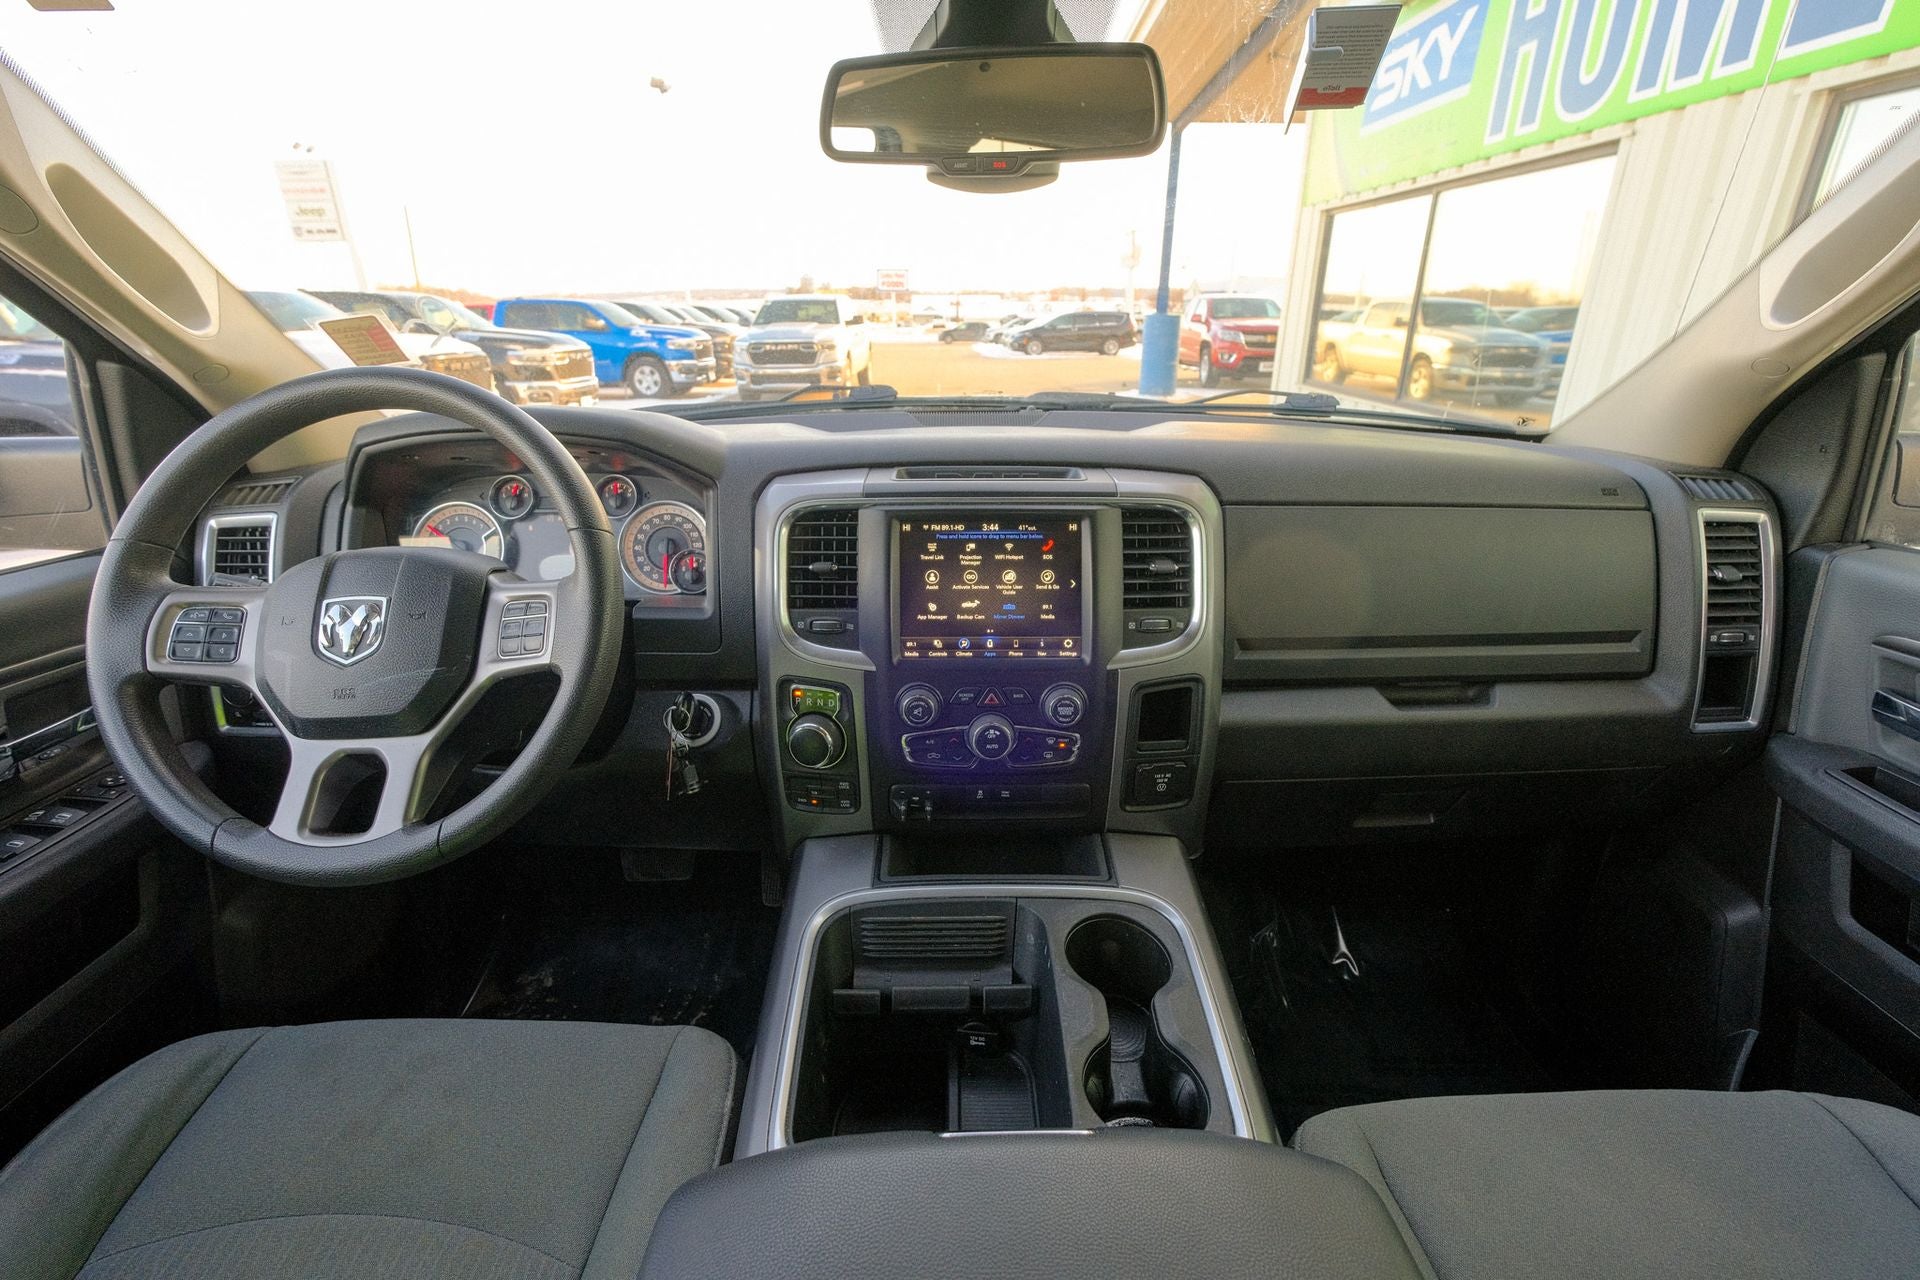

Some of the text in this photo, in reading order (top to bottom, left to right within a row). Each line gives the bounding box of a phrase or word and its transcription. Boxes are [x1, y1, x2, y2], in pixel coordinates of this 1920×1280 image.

[1369, 4, 1480, 113] SKY
[902, 523, 911, 532] HI
[982, 523, 999, 532] 3:44
[1068, 523, 1078, 532] HI
[988, 533, 999, 541] drag
[795, 697, 801, 705] P
[806, 697, 813, 705] R
[817, 698, 823, 706] N
